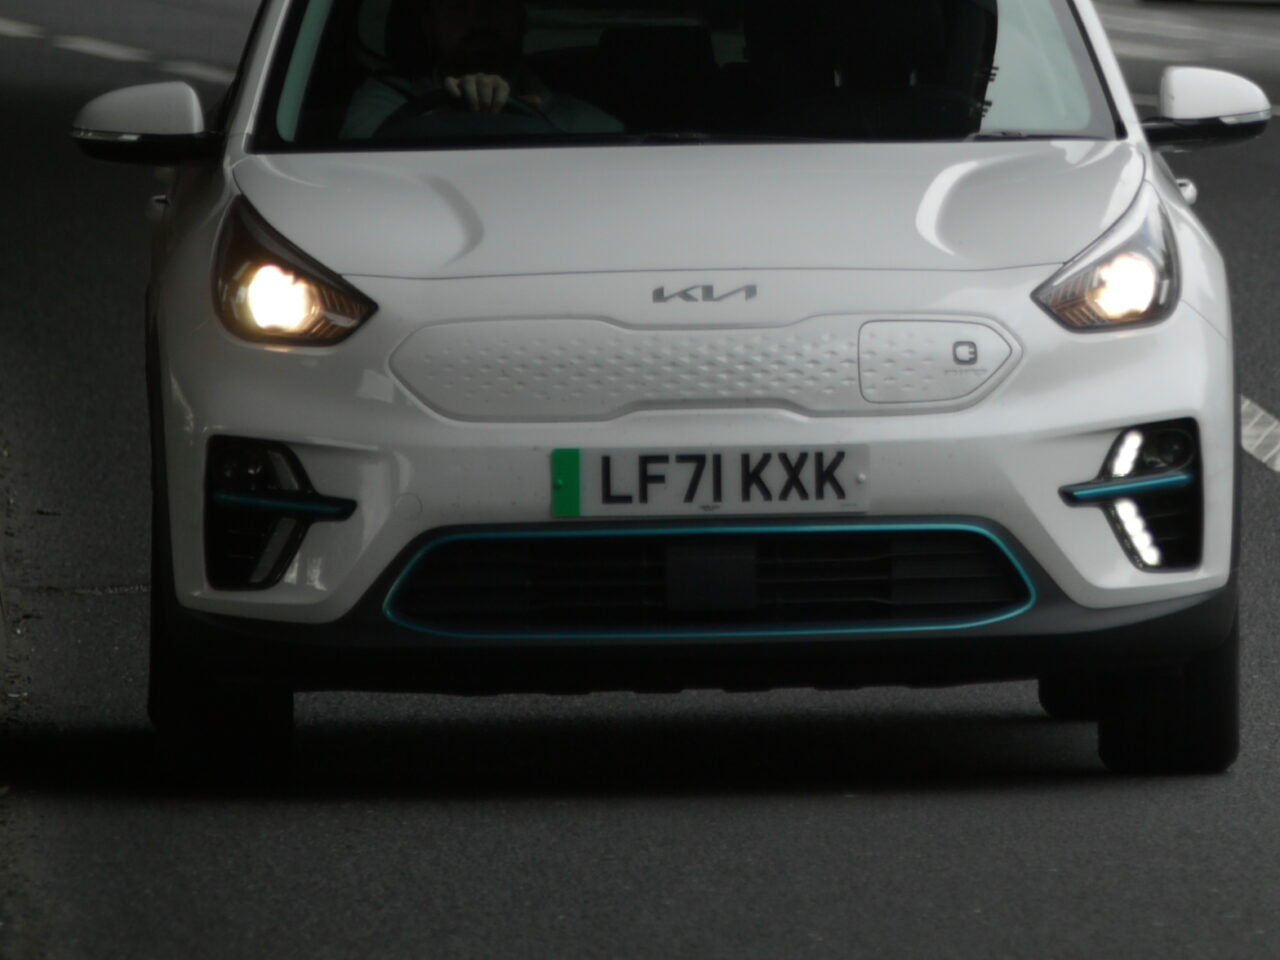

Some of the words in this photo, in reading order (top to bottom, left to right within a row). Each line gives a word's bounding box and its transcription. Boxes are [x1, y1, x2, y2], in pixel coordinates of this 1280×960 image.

[652, 285, 758, 303] KIA
[601, 453, 722, 504] LF71
[740, 451, 846, 502] KXK
